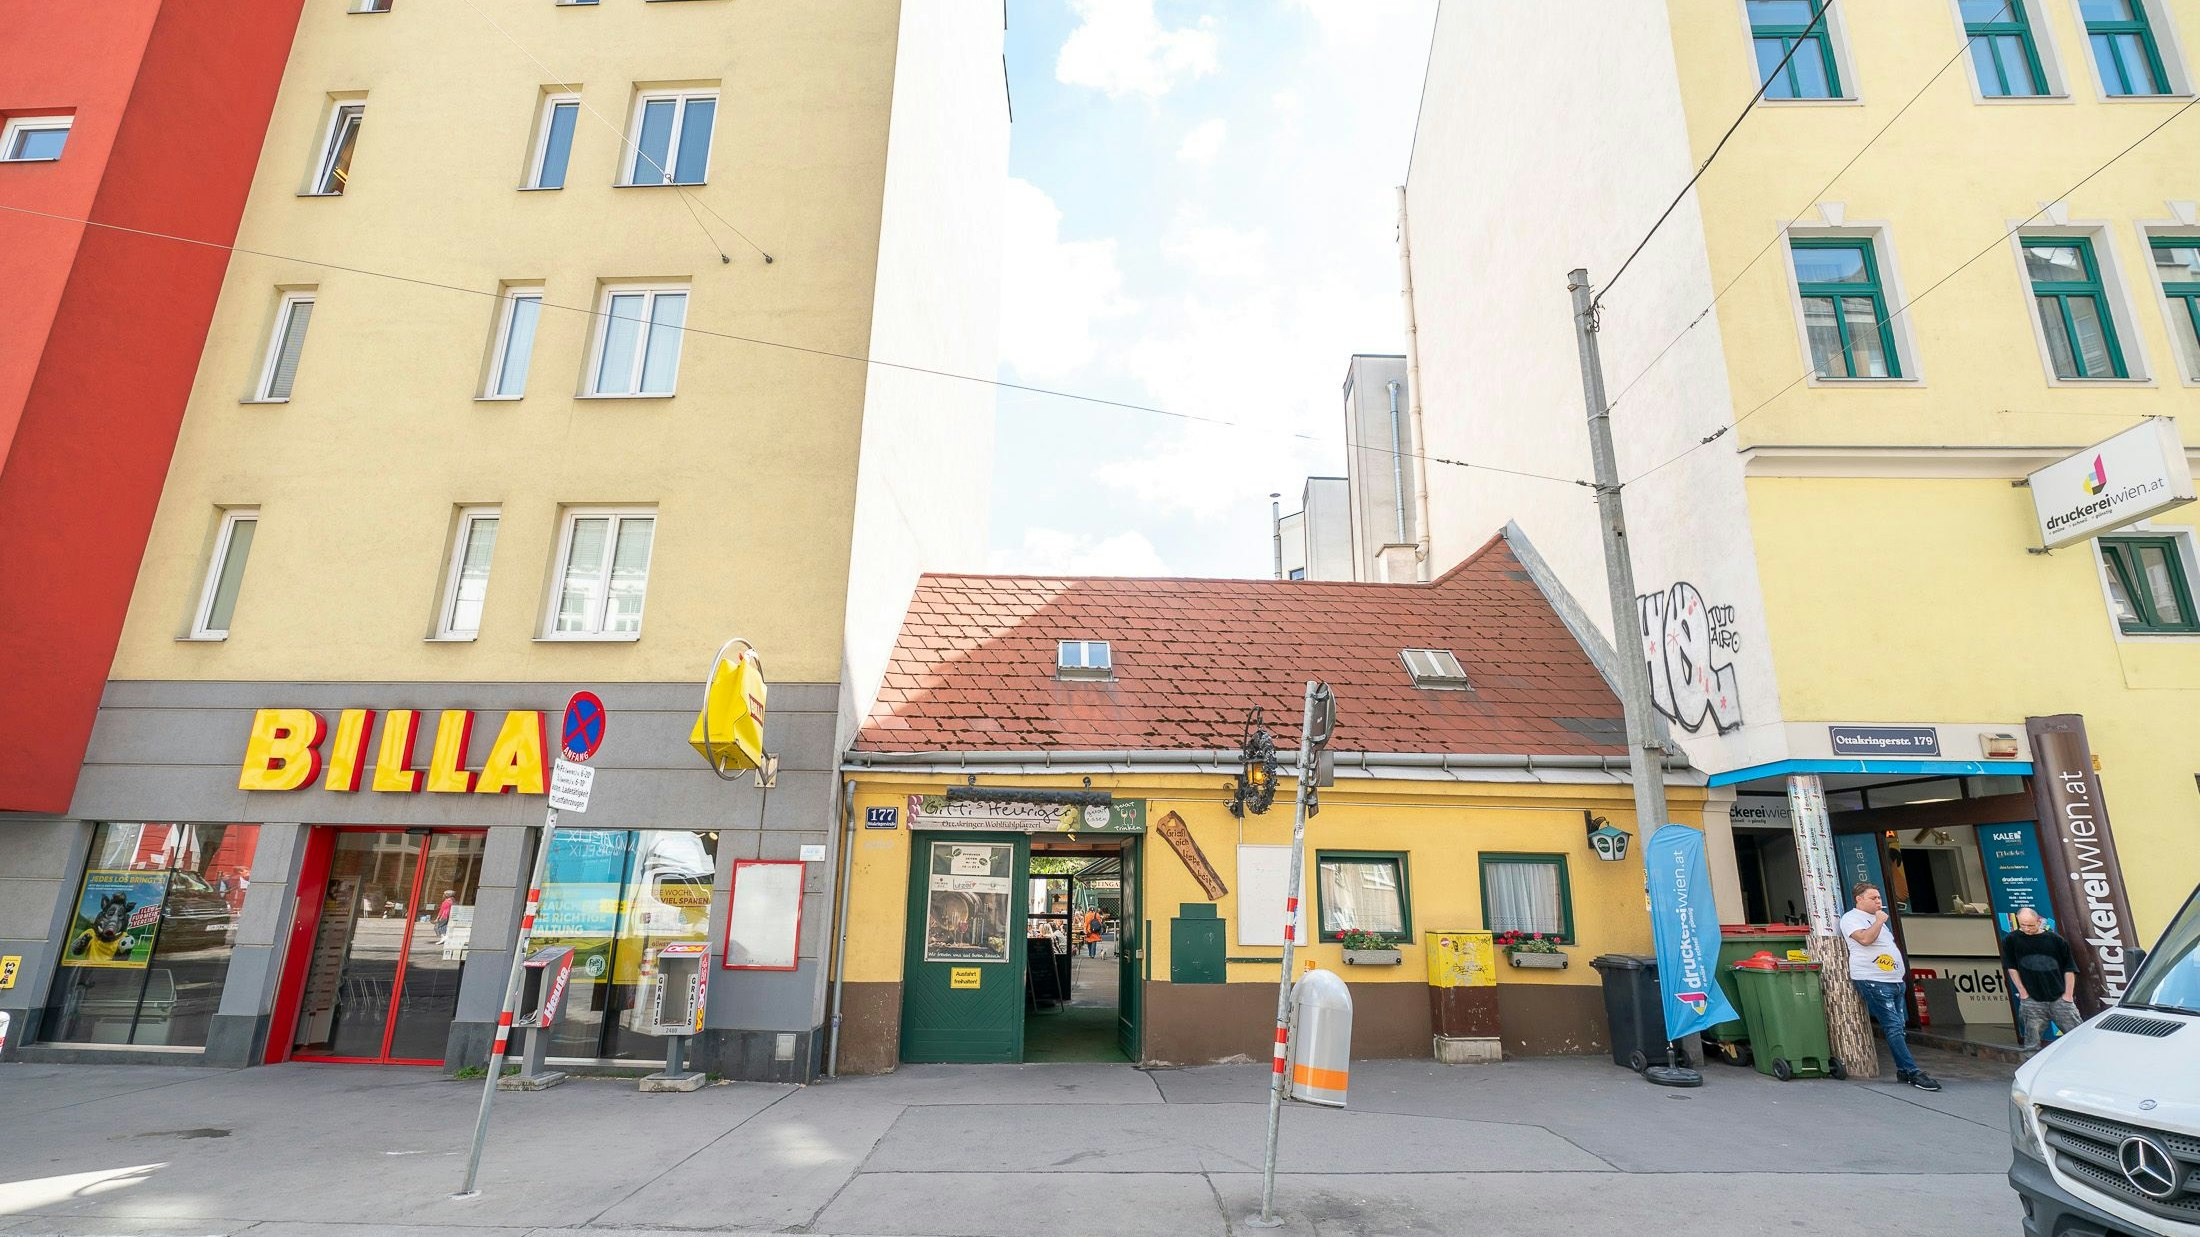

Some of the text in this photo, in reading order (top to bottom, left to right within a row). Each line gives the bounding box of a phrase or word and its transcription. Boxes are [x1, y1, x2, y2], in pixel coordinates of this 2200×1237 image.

[2046, 478, 2164, 530] druckereiwien.at
[238, 709, 549, 794] BILLA
[563, 746, 589, 761] ANFANG
[1836, 735, 1933, 747] Ottakringerstr. 179
[871, 809, 895, 821] 177
[989, 802, 1071, 823] Heuriger
[2059, 771, 2127, 1005] ruckereiwien.at
[1673, 849, 1702, 989] druckereiwien.at
[653, 976, 663, 1026] GRATIS
[687, 976, 697, 1026] GRATIS
